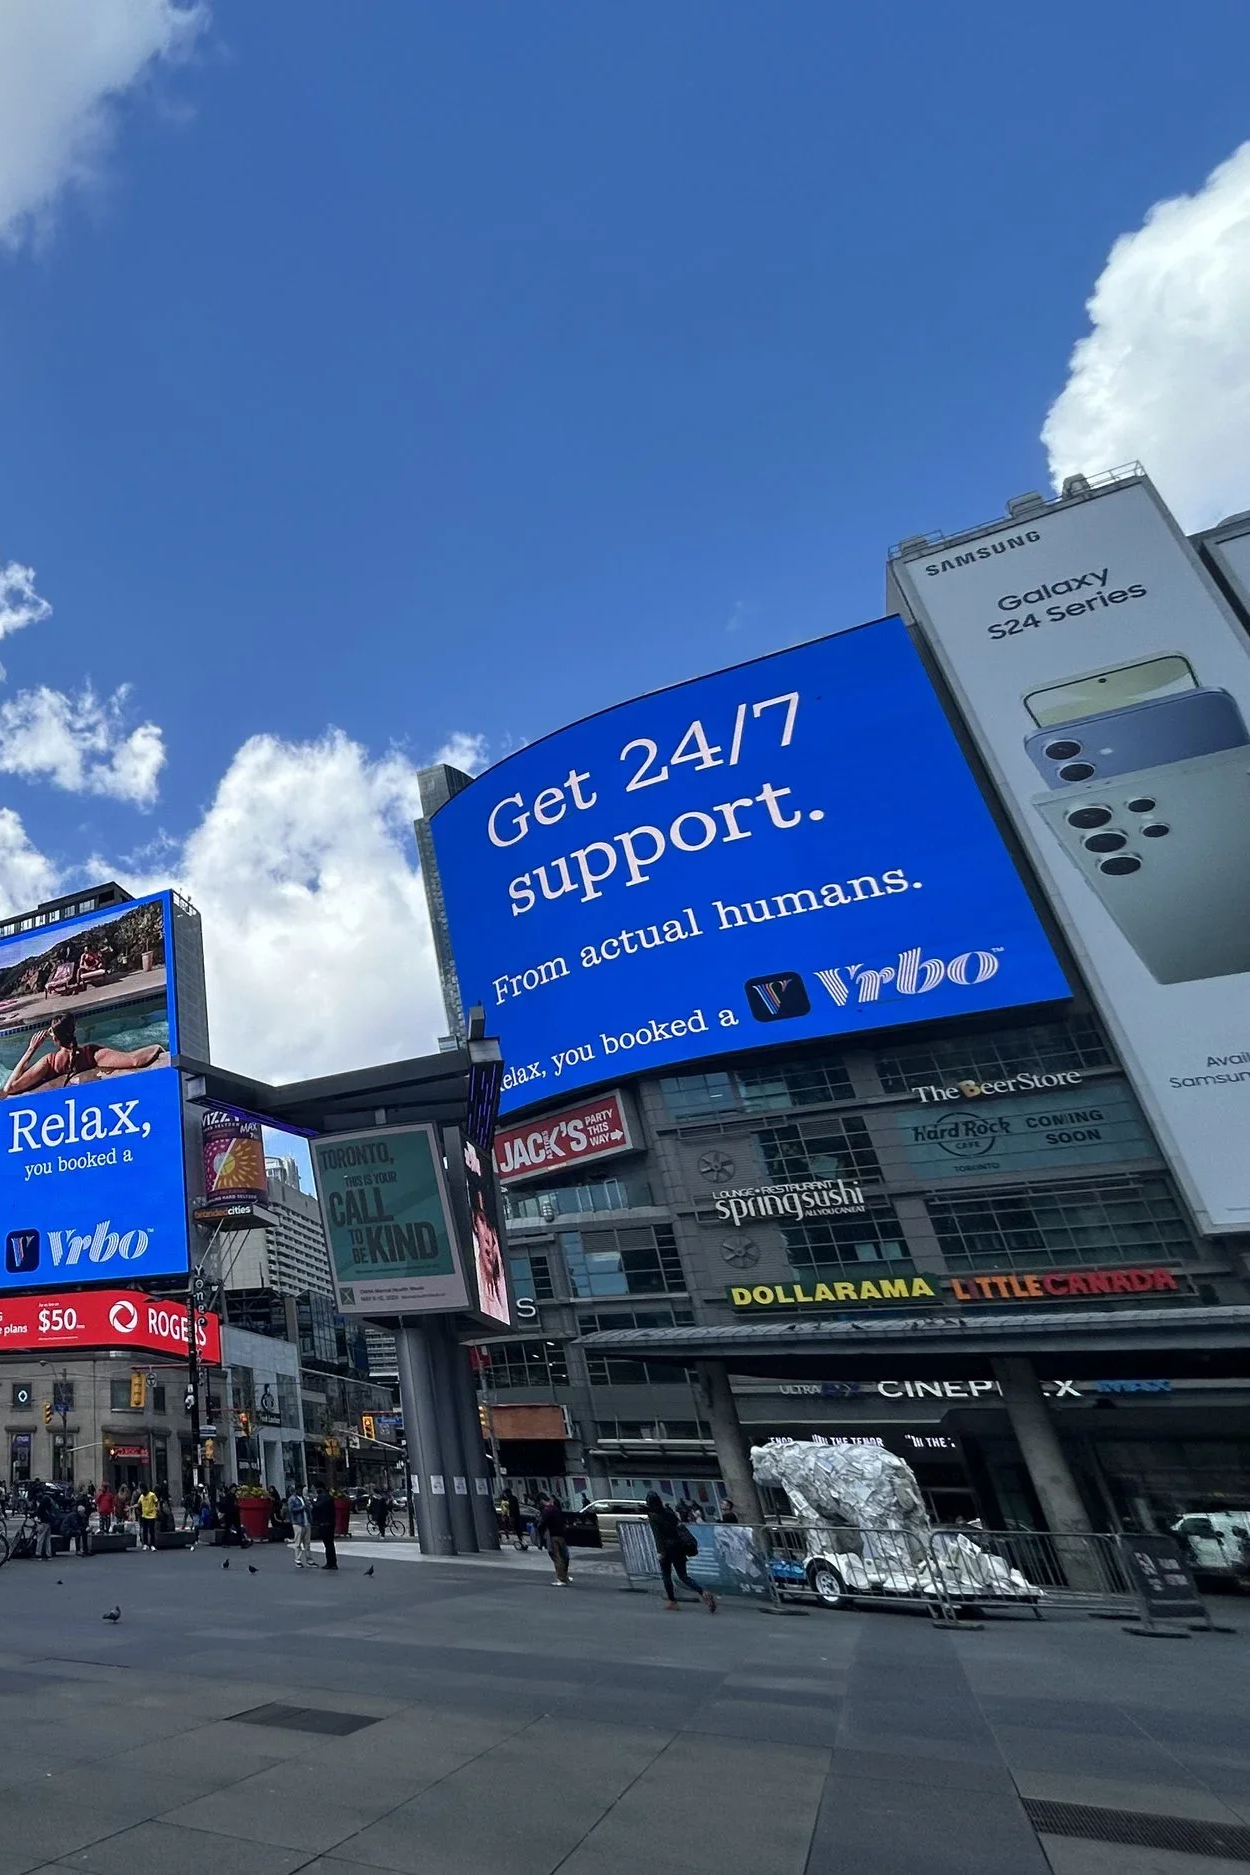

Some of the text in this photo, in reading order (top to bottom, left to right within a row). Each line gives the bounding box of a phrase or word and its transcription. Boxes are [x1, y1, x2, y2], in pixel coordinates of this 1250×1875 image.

[925, 529, 1042, 577] SAMSUNG
[997, 566, 1110, 613] Galaxy
[986, 581, 1147, 642] S24 Series
[488, 691, 801, 848] Get 24/7
[509, 782, 825, 916] support.
[493, 867, 923, 1006] From actual humans.
[551, 1042, 596, 1078] you
[602, 1008, 708, 1055] booked
[719, 1008, 738, 1027] a
[7, 1098, 152, 1154] Relax,
[584, 1108, 613, 1126] PARTY
[587, 1122, 609, 1136] THIS
[963, 1117, 1010, 1137] Rock
[1025, 1109, 1104, 1129] COMING
[589, 1133, 611, 1147] WAY
[955, 1129, 1102, 1150] CAFE SOON
[24, 1149, 134, 1182] you booked a
[317, 1142, 394, 1171] TORONTO,
[953, 1162, 1000, 1173] TORONTO
[345, 1171, 398, 1188] THIS IS YOUR
[712, 1180, 834, 1200] LOUNGE RESTAURANT
[329, 1186, 394, 1228] CALL
[349, 1228, 364, 1245] TO
[352, 1221, 439, 1264] BE KIND
[731, 1268, 1178, 1306] DOLLARAMA LITTLE CANADA
[4, 1324, 28, 1336] plans
[38, 1308, 77, 1333] $50
